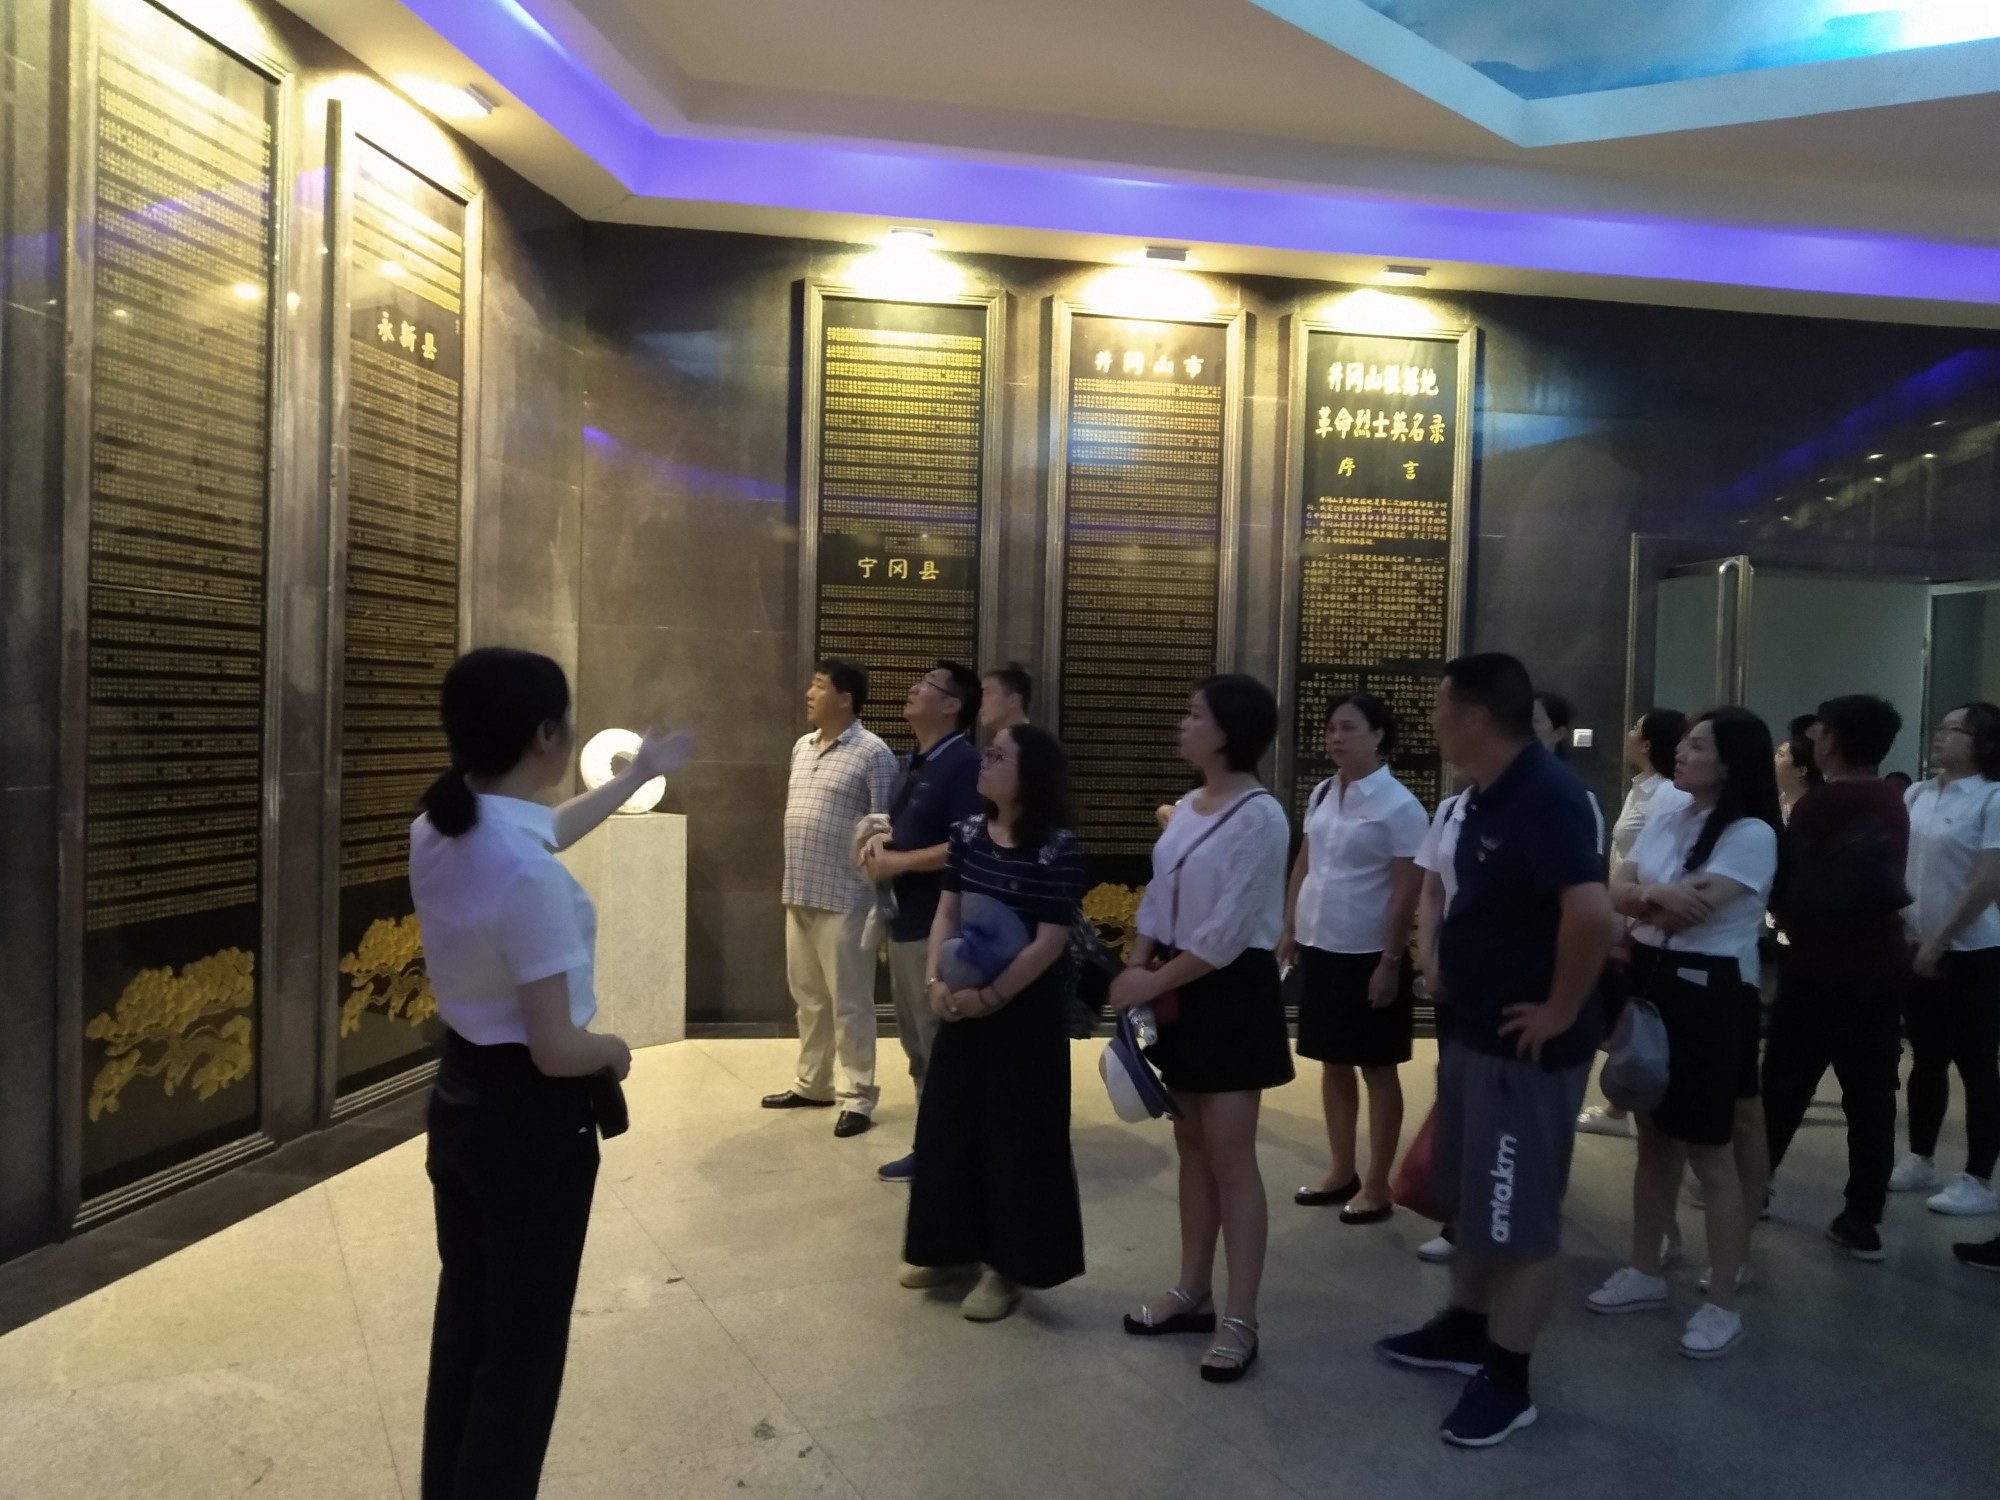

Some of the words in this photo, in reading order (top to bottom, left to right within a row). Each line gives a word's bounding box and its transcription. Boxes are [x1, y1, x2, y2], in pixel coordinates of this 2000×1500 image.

[1094, 350, 1204, 379] 井冈山市
[1315, 405, 1446, 444] 革命烈士英名录
[857, 556, 940, 581] 宁冈县
